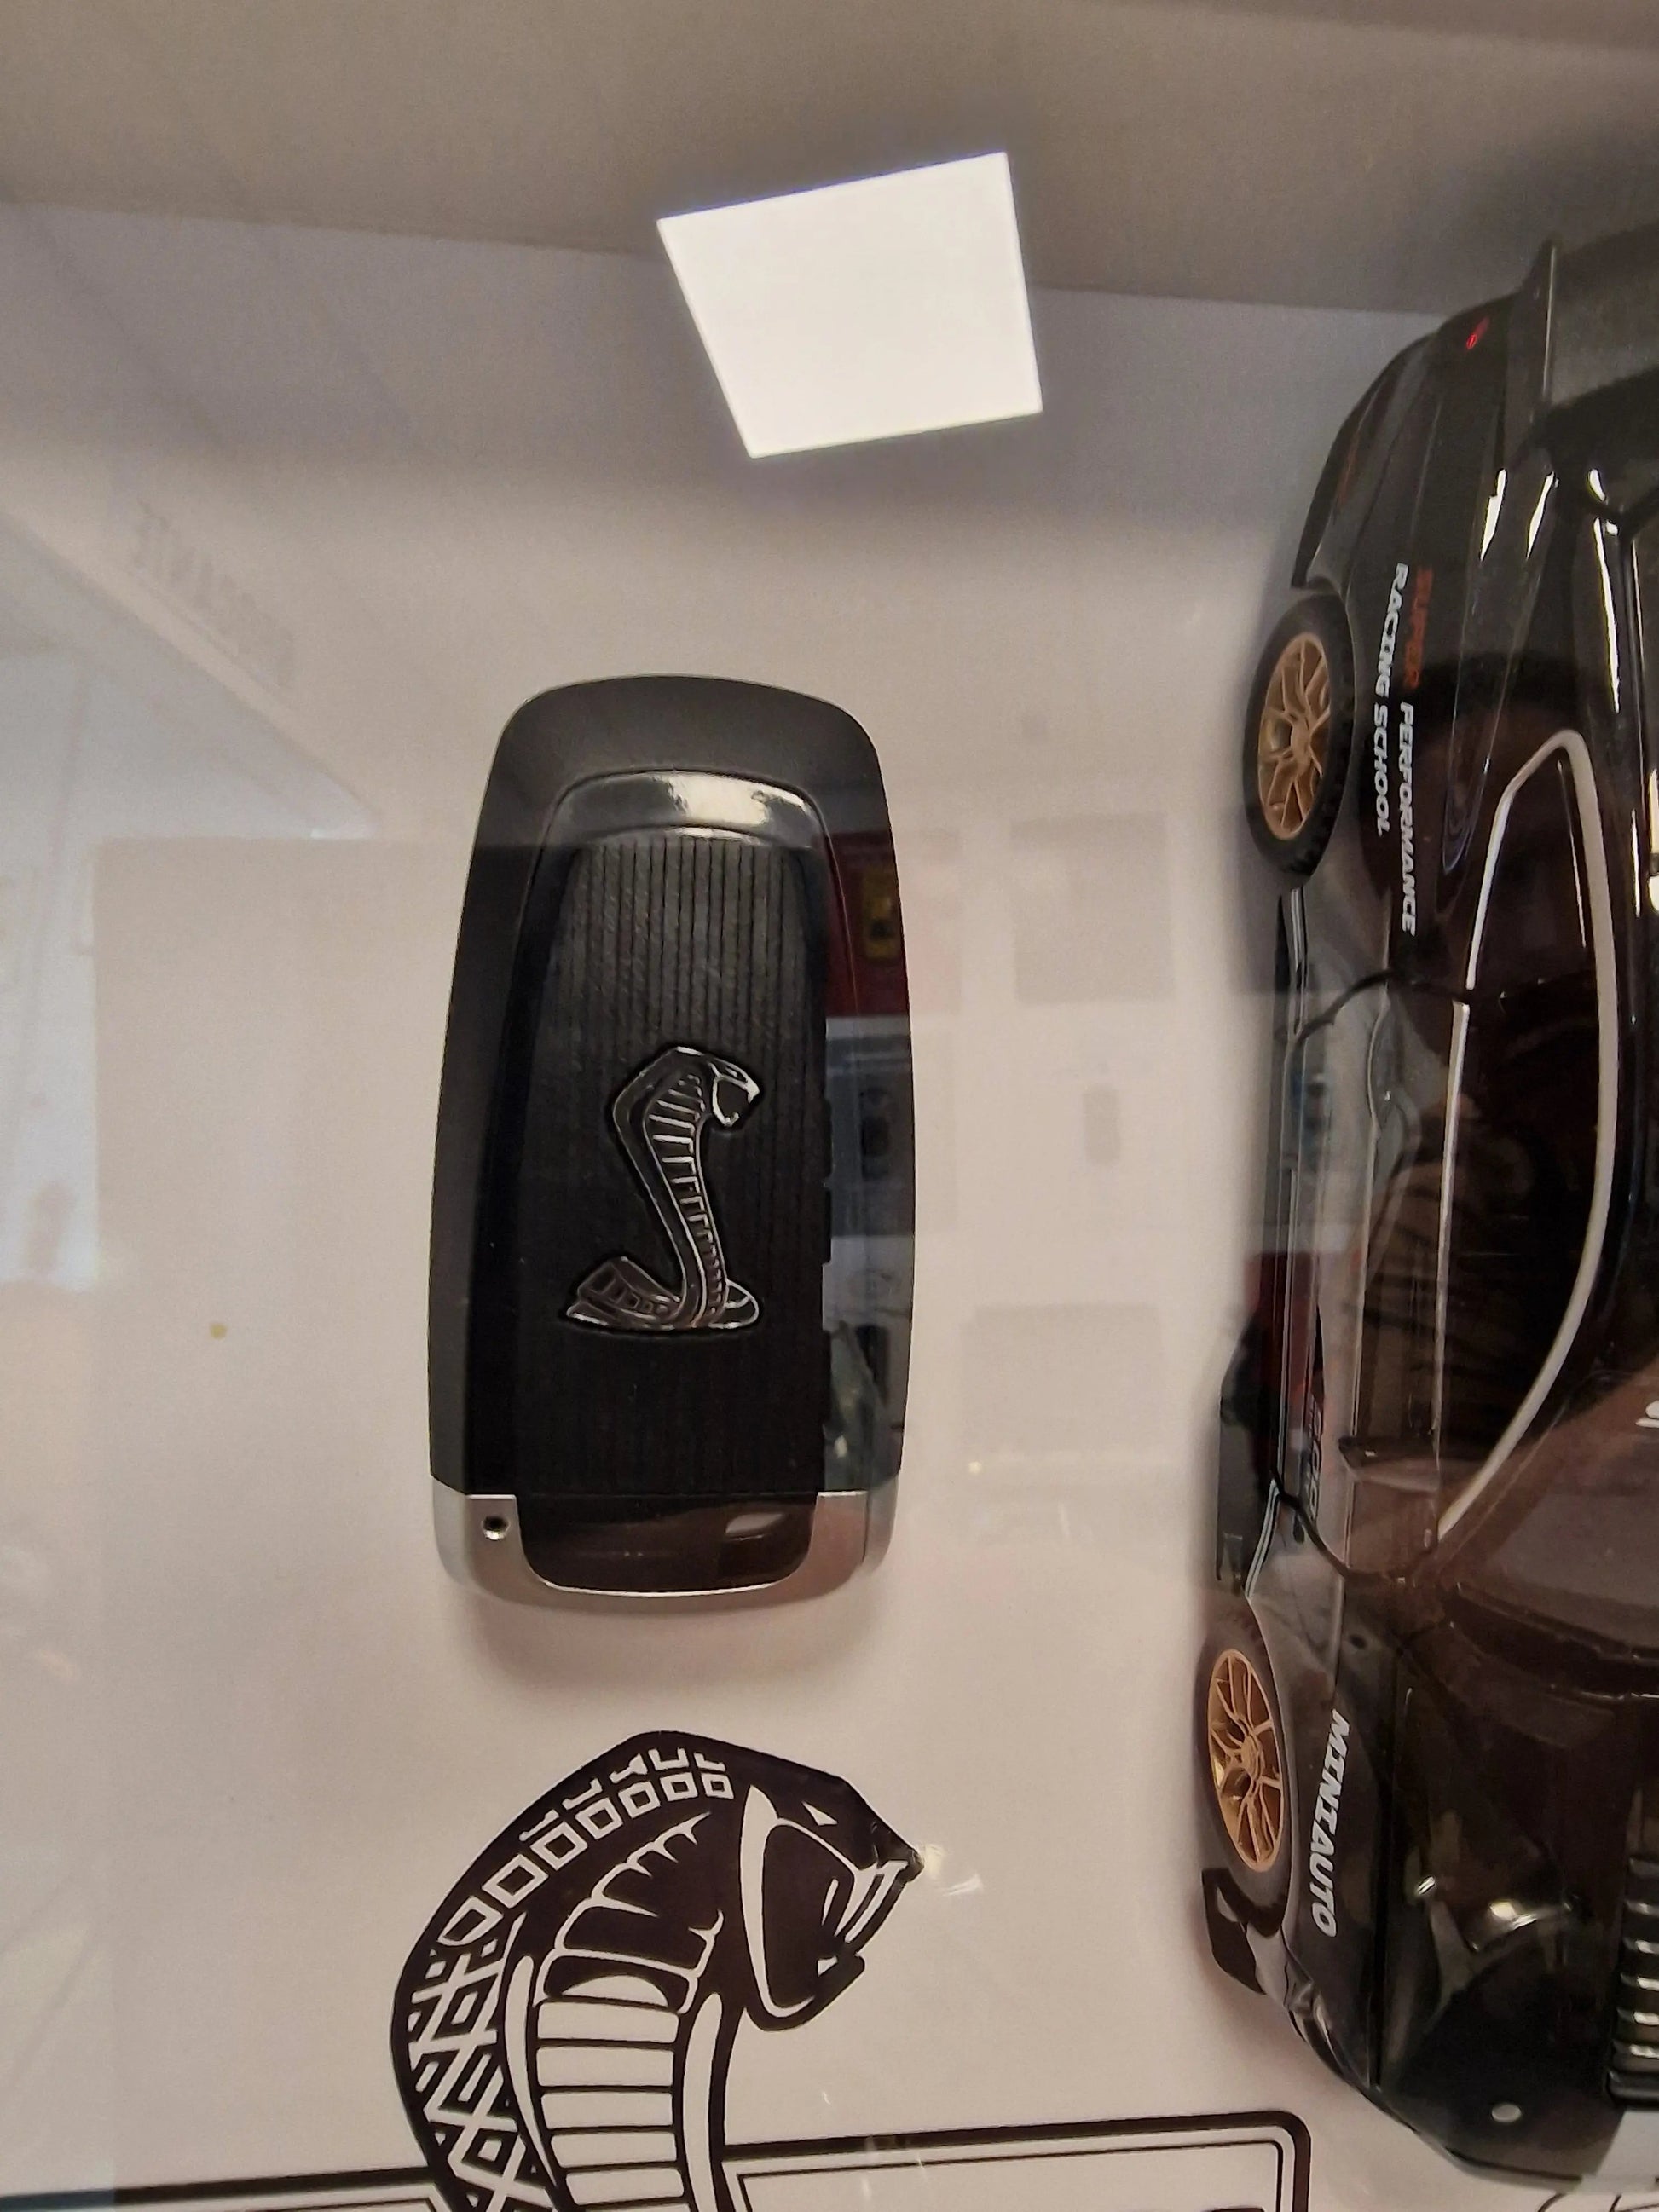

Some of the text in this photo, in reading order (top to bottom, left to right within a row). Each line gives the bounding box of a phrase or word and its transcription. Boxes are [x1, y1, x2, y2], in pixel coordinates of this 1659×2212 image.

[1373, 563, 1408, 836] RACING SCHOOL
[1399, 702, 1416, 937] PERFORMANCE
[1309, 1708, 1350, 1937] MINIAUTO
